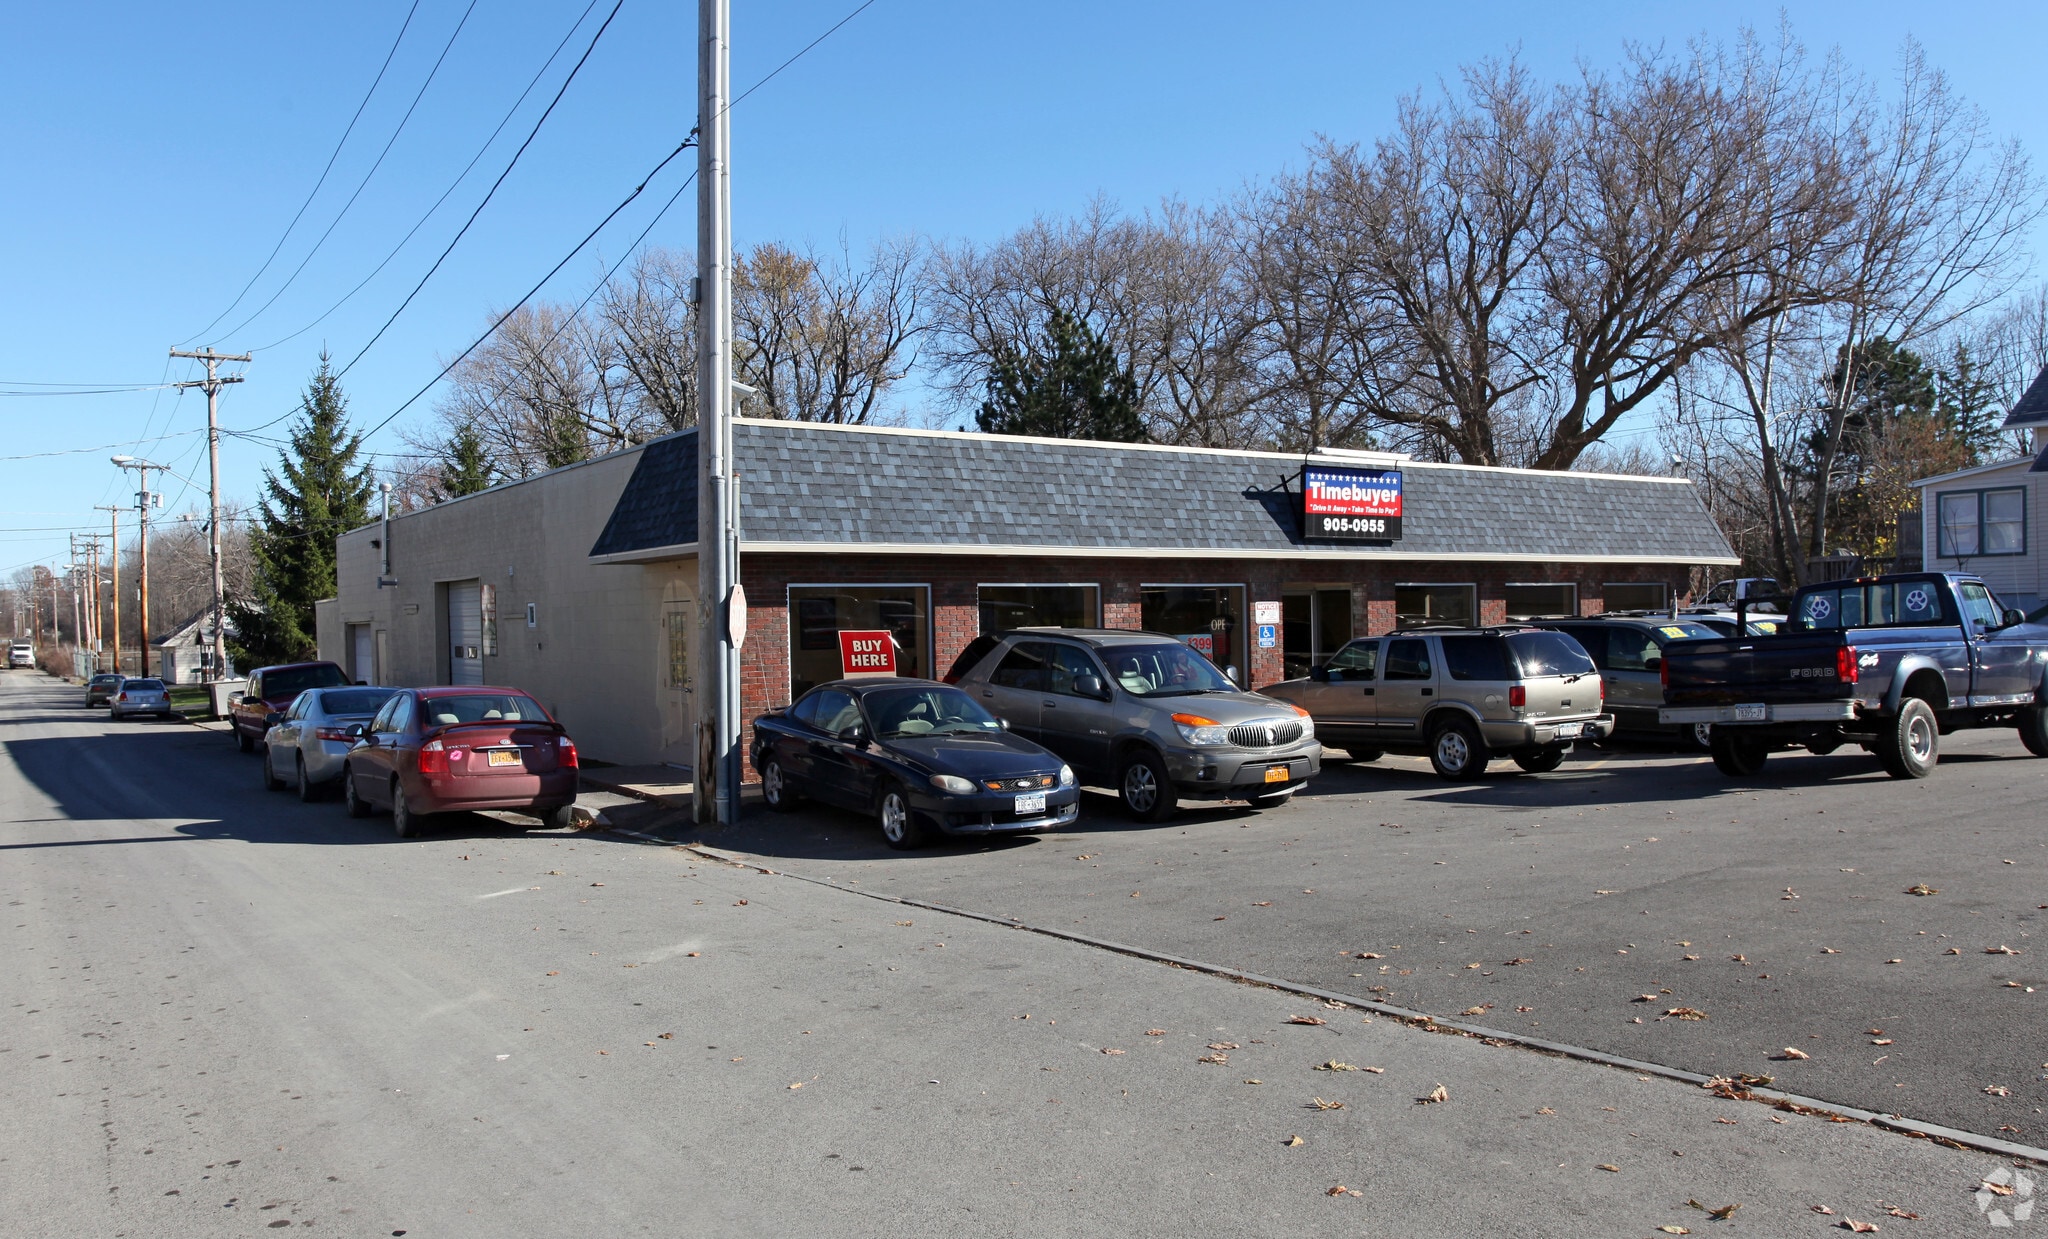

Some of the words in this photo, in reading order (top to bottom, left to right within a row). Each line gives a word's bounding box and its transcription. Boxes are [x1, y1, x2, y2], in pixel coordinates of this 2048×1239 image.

[1309, 481, 1398, 506] Timebuyer
[1333, 505, 1347, 513] Away
[1323, 517, 1385, 532] 905-0955
[852, 640, 882, 652] BUY
[1187, 637, 1212, 650] $399
[850, 653, 888, 667] HERE
[1790, 667, 1835, 677] FORD
